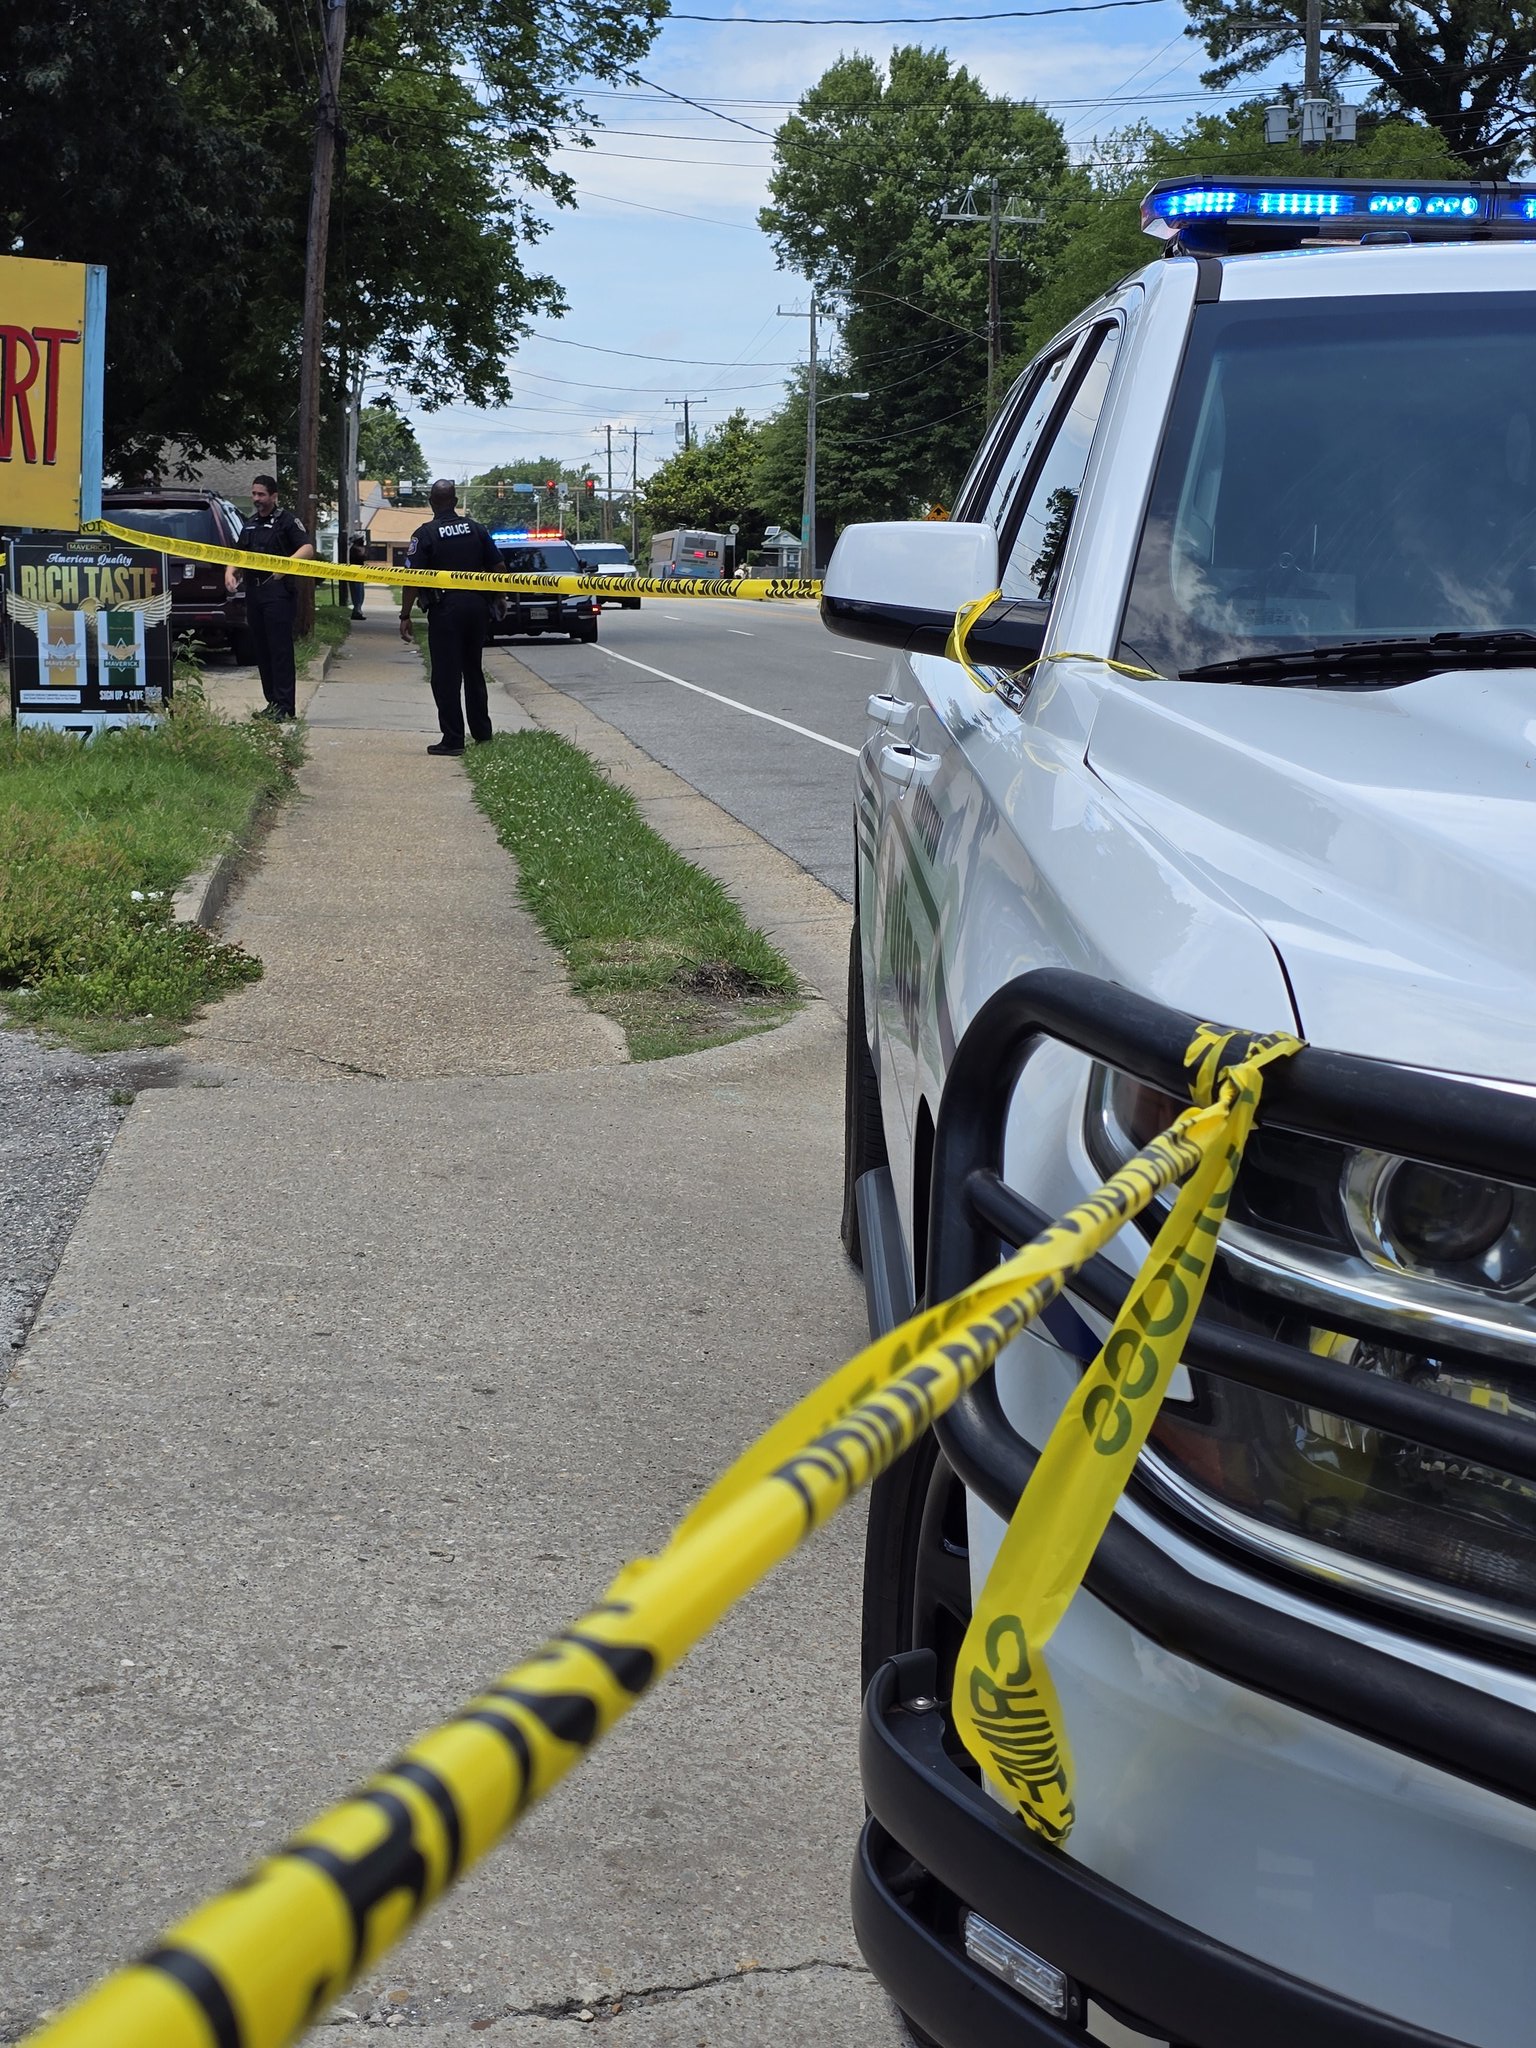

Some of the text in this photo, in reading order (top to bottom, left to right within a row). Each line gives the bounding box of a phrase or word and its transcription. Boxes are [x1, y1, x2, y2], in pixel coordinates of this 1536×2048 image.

[439, 523, 471, 538] POLICE
[69, 543, 108, 552] MAVERICK
[46, 552, 133, 567] American Quality
[20, 565, 158, 604] RICH TASTE
[115, 690, 123, 700] UP
